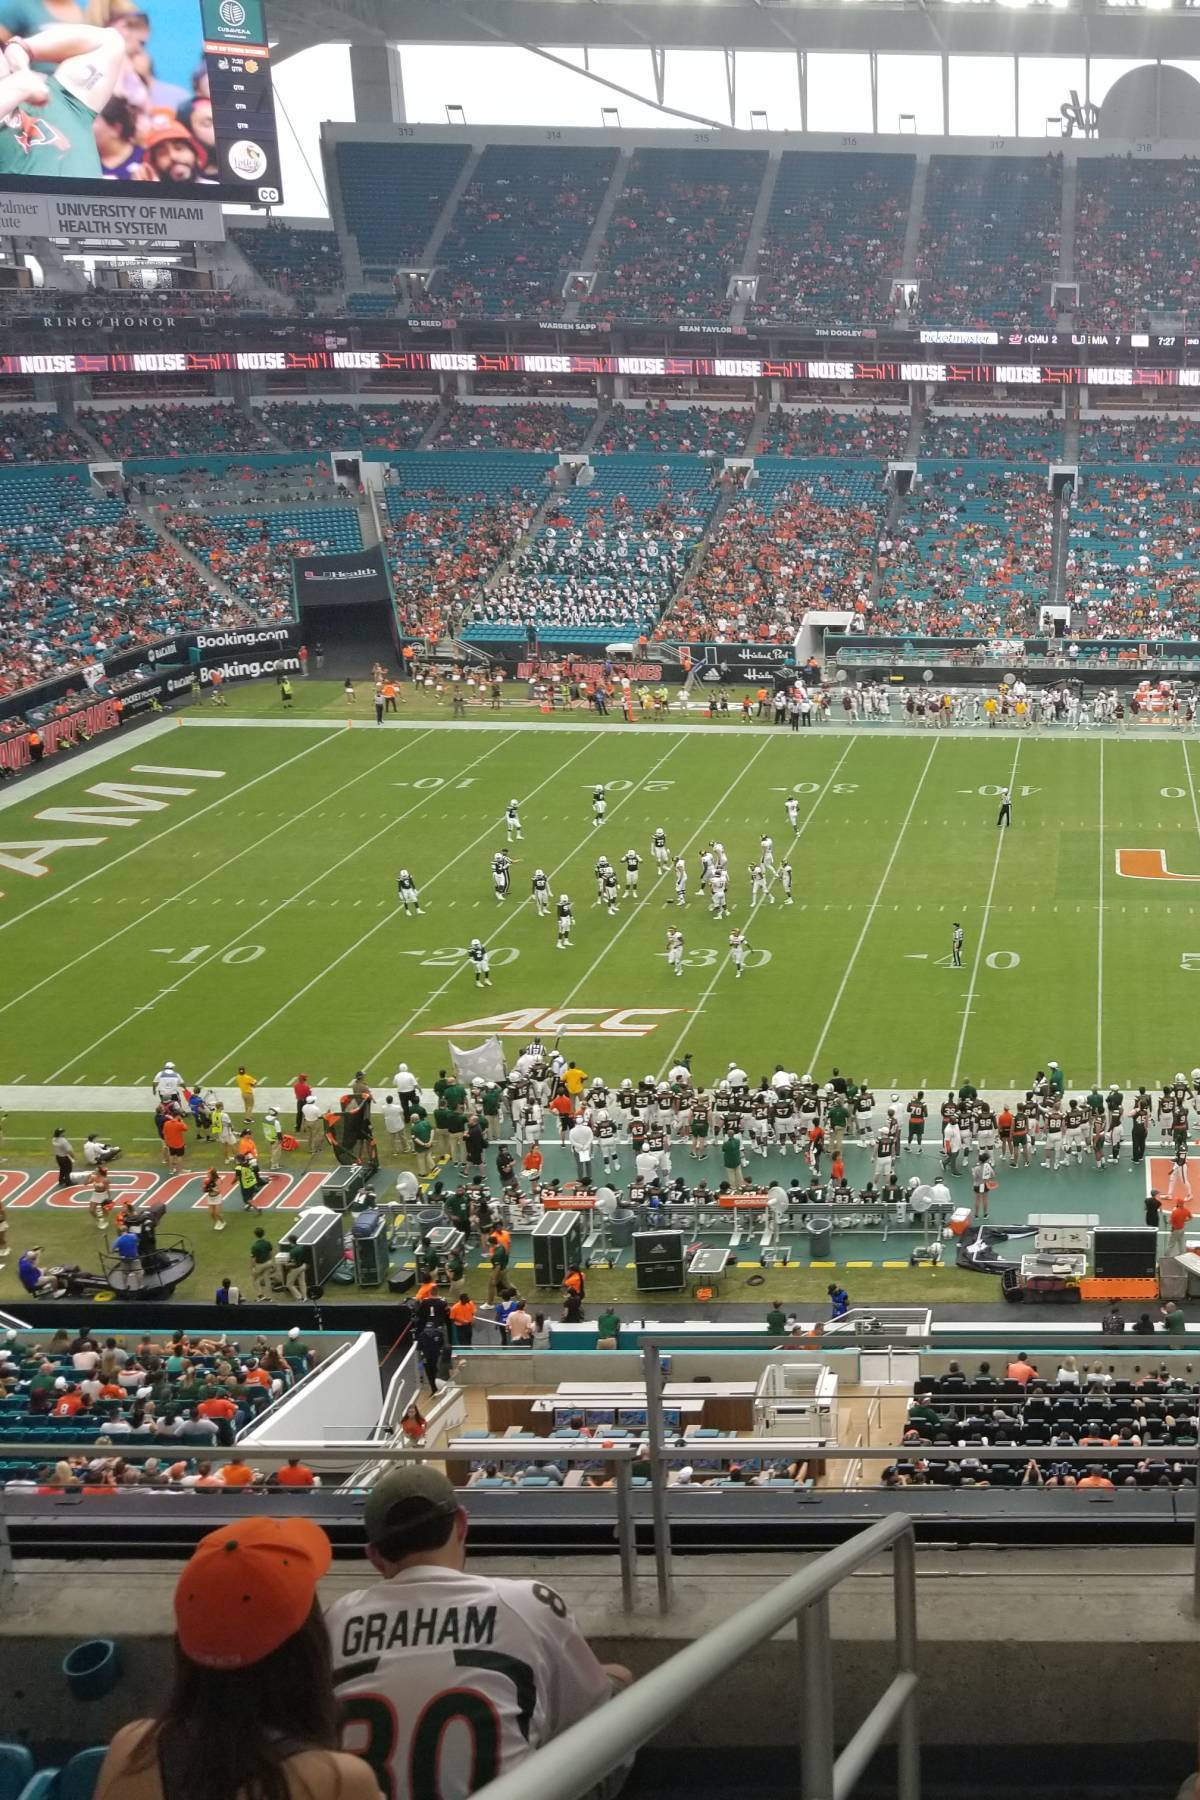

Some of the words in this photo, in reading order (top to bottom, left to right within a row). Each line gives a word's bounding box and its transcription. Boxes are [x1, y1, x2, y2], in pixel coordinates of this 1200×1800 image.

[56, 202, 142, 219] UNIVERSITY
[143, 205, 157, 219] OF
[160, 207, 204, 221] MIAMI
[59, 219, 114, 234] HEALTH
[115, 221, 168, 235] SYSTEM
[43, 317, 91, 327] RING
[110, 317, 176, 328] HONOR
[539, 322, 574, 330] WARREN
[679, 325, 700, 333] SEAN
[701, 326, 732, 334] TAYLOR
[1028, 336, 1049, 344] CMU
[1052, 336, 1058, 344] 2
[1092, 336, 1109, 345] MIA
[1115, 337, 1120, 345] 7
[1158, 337, 1176, 346] 7:27
[20, 355, 76, 374] NOISE
[134, 354, 185, 372] NOISE
[237, 353, 285, 370] NOISE
[334, 352, 380, 369] NOISE
[430, 354, 477, 371] NOISE
[525, 355, 571, 373] NOISE
[618, 357, 665, 375] NOISE
[715, 359, 761, 377] NOISE
[808, 362, 853, 379] NOISE
[901, 364, 946, 381] NOISE
[996, 366, 1041, 383] NOISE
[1087, 367, 1132, 385] NOISE
[197, 629, 289, 650] Booking.com
[167, 944, 267, 965] 10
[418, 1007, 690, 1037] ACC
[693, 1111, 706, 1121] 72
[910, 1106, 922, 1116] 70
[599, 1127, 613, 1137] 22
[649, 1138, 662, 1148] 35
[342, 1605, 497, 1657] GRAHAM
